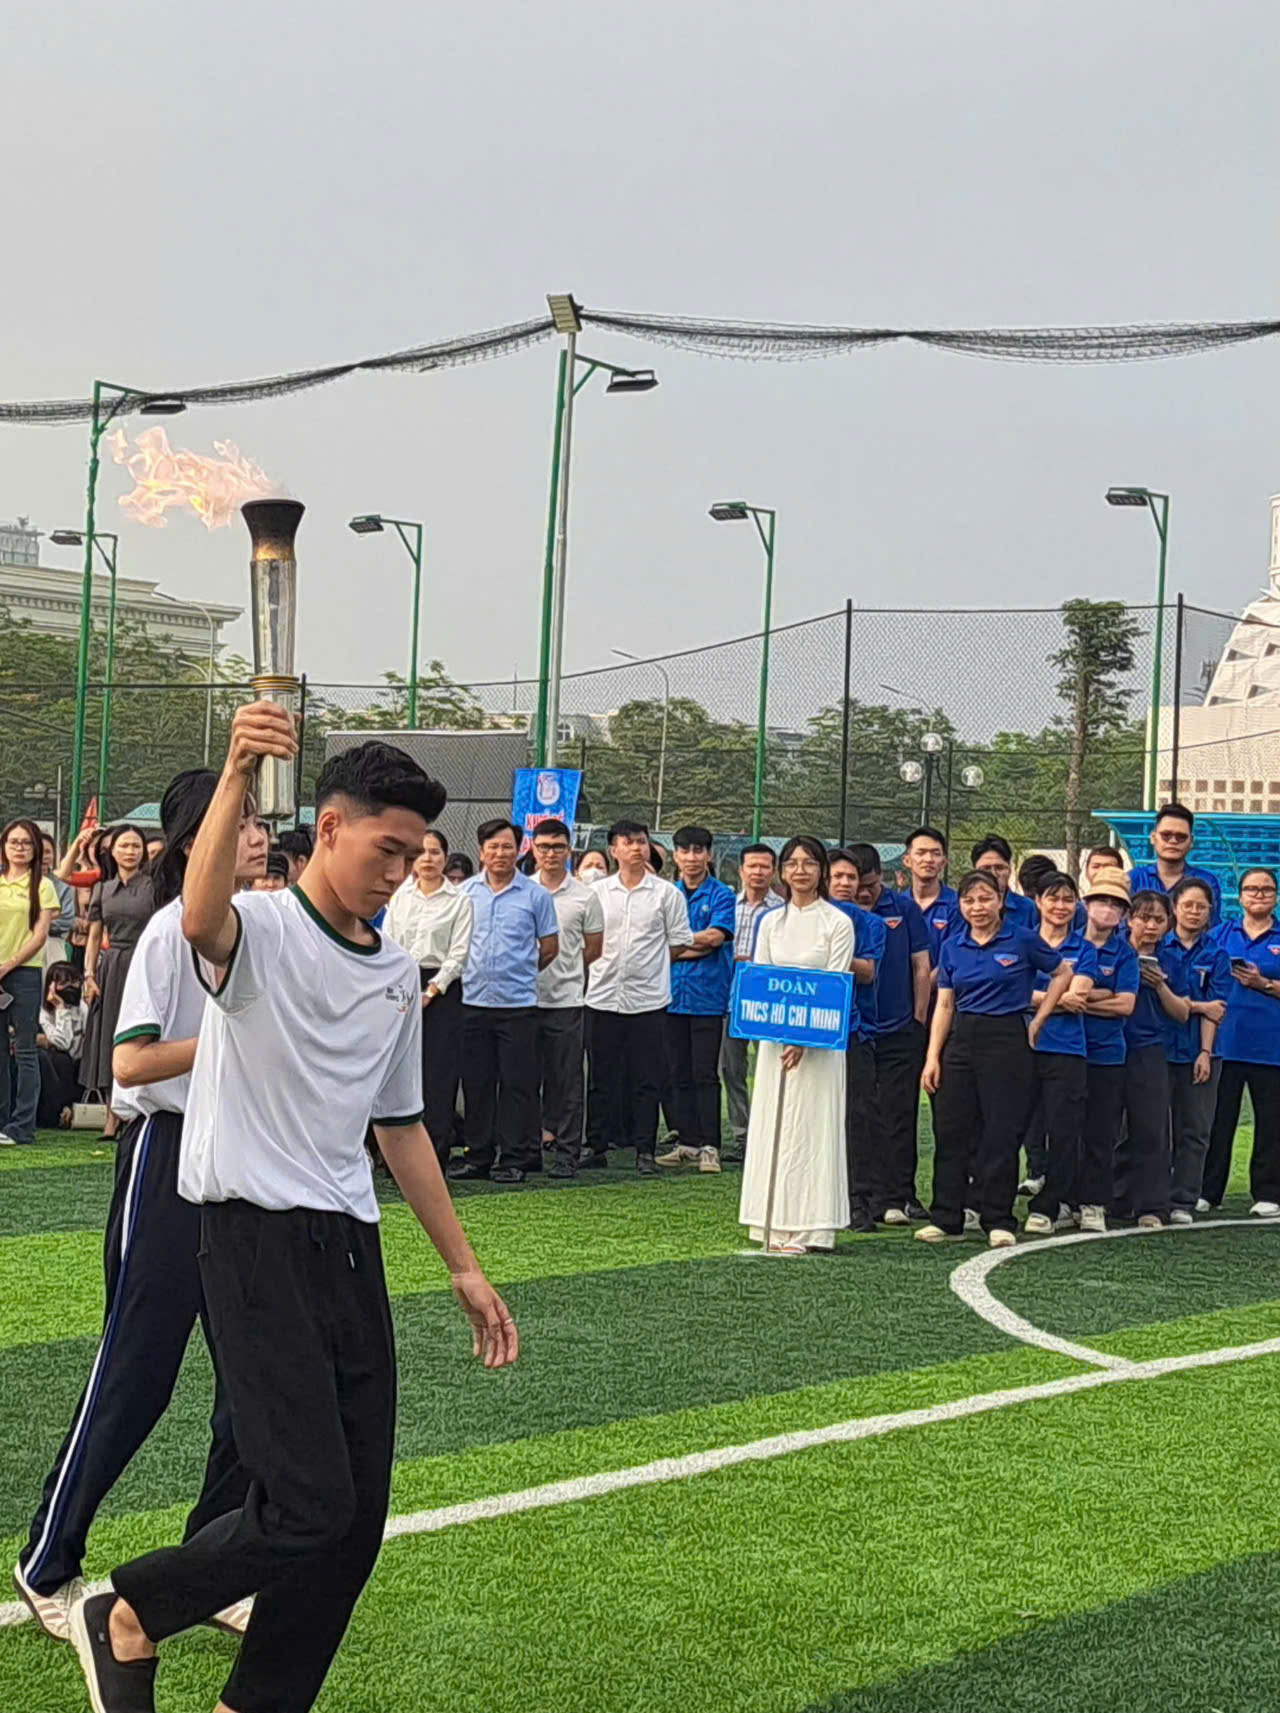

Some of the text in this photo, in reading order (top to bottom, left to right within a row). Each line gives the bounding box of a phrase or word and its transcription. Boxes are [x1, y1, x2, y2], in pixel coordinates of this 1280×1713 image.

[767, 976, 817, 996] ĐOÀN
[741, 999, 769, 1022] TNCS
[788, 1002, 808, 1027] CHÍ
[809, 1006, 841, 1032] MINH
